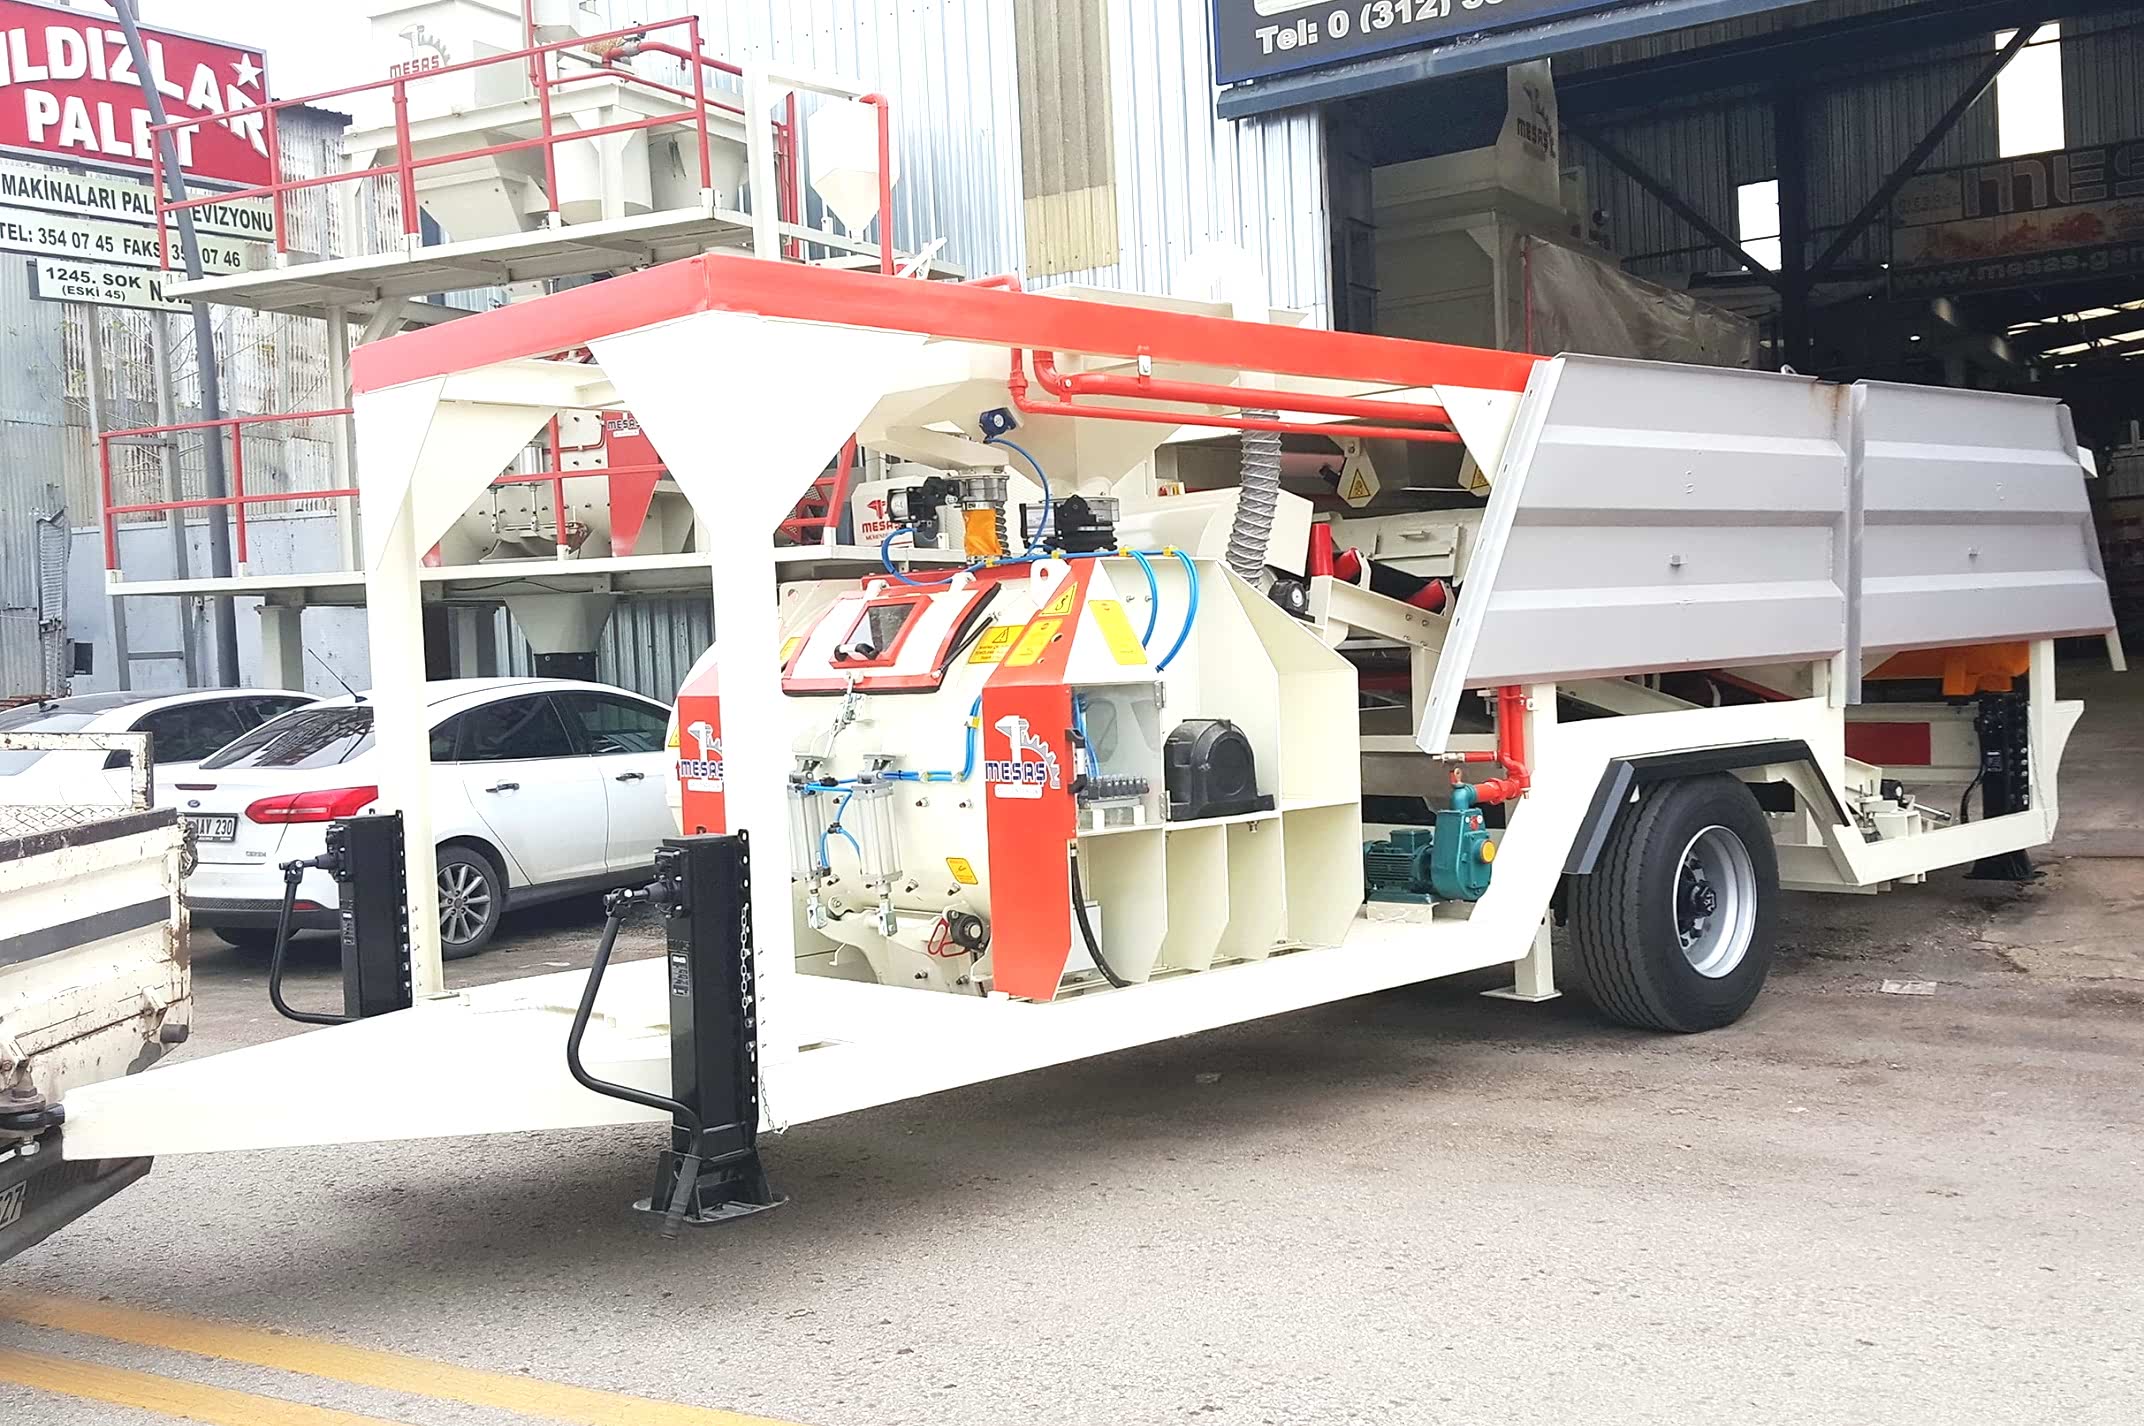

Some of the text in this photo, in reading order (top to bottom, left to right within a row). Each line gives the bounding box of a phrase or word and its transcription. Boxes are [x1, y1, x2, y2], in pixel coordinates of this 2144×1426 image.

[1255, 19, 1318, 54] Tel:
[1327, 10, 1349, 38] 0
[2, 173, 116, 210] MAKİNALARI
[122, 192, 174, 219] PALT
[0, 222, 33, 243] TEL:
[38, 227, 67, 247] 354
[72, 232, 90, 250] 07
[96, 235, 114, 252] 45
[202, 248, 218, 265] 07
[224, 251, 241, 267] 46
[46, 267, 142, 289] 1245. SOK
[62, 284, 126, 302] (ESKİ 45)
[215, 819, 232, 835] 230
[0, 1184, 24, 1225] 27
